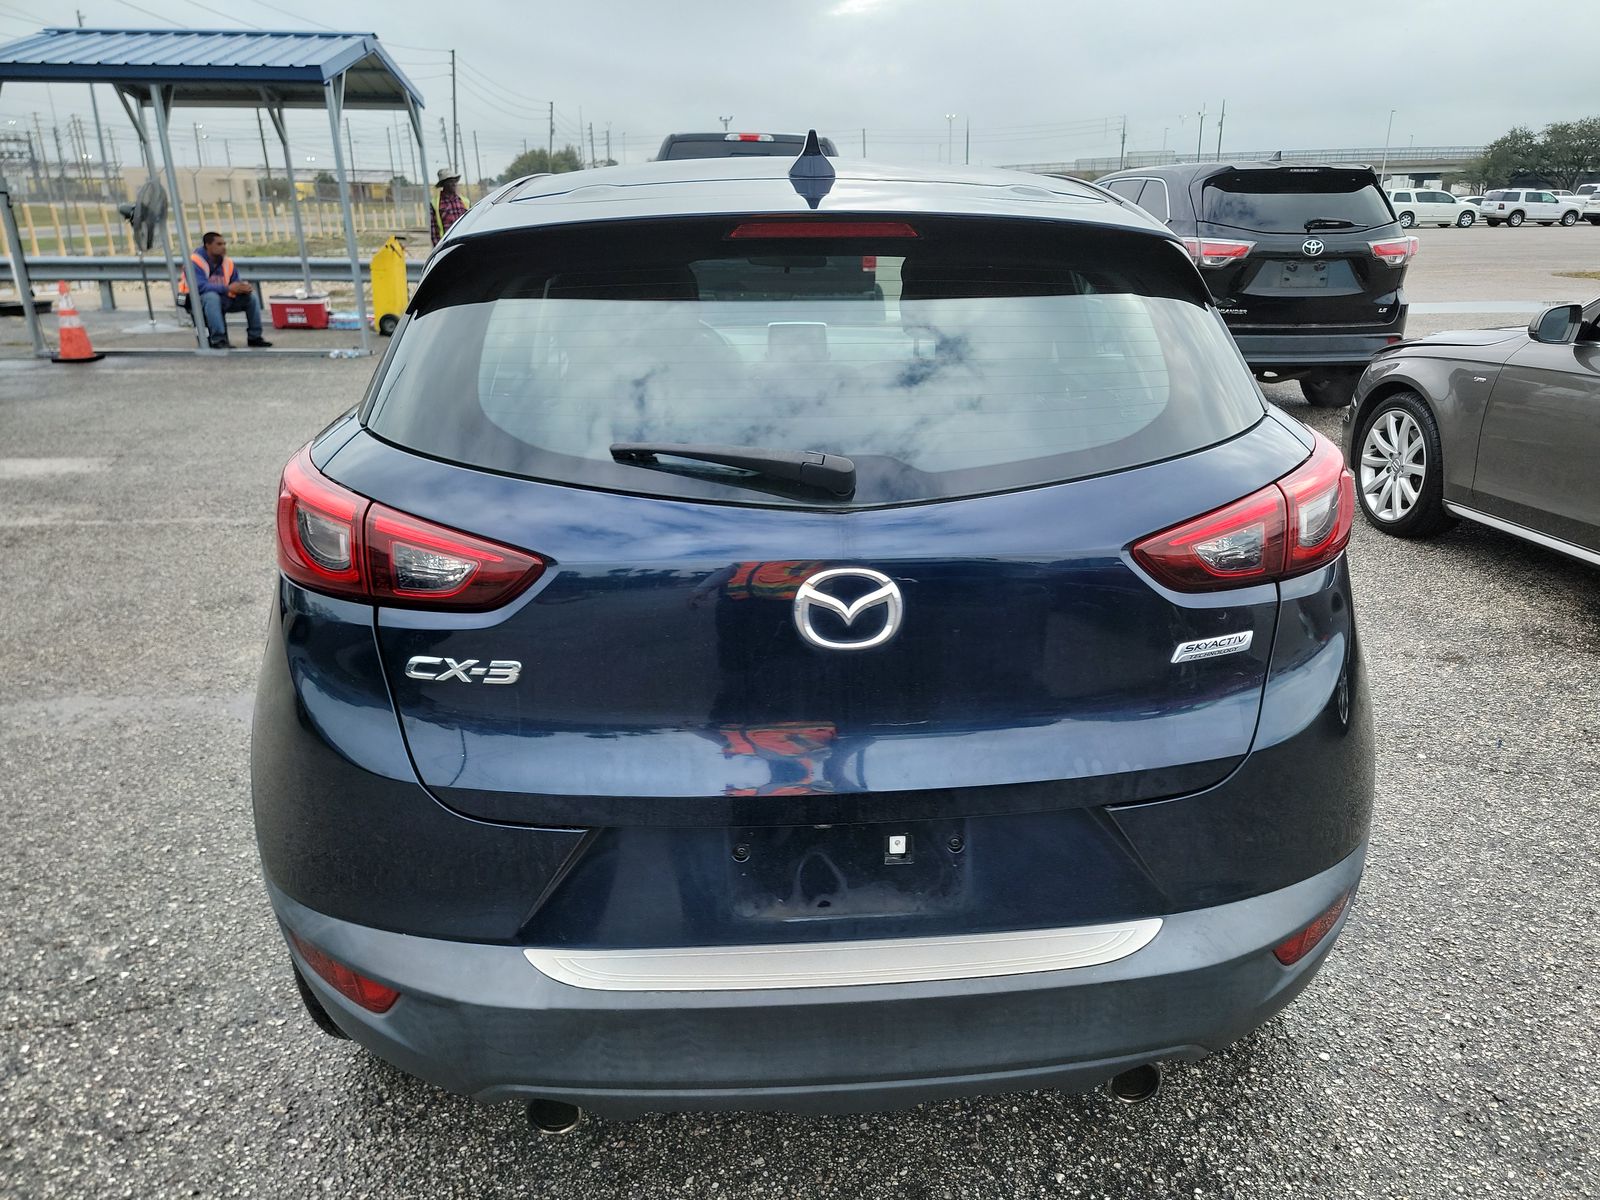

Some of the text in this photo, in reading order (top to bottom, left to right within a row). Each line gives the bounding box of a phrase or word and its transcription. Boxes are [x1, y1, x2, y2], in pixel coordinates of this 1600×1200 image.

[1184, 634, 1247, 653] SKYACTIV
[1189, 646, 1239, 660] TECHNOLOGY
[405, 655, 522, 685] CX-3
